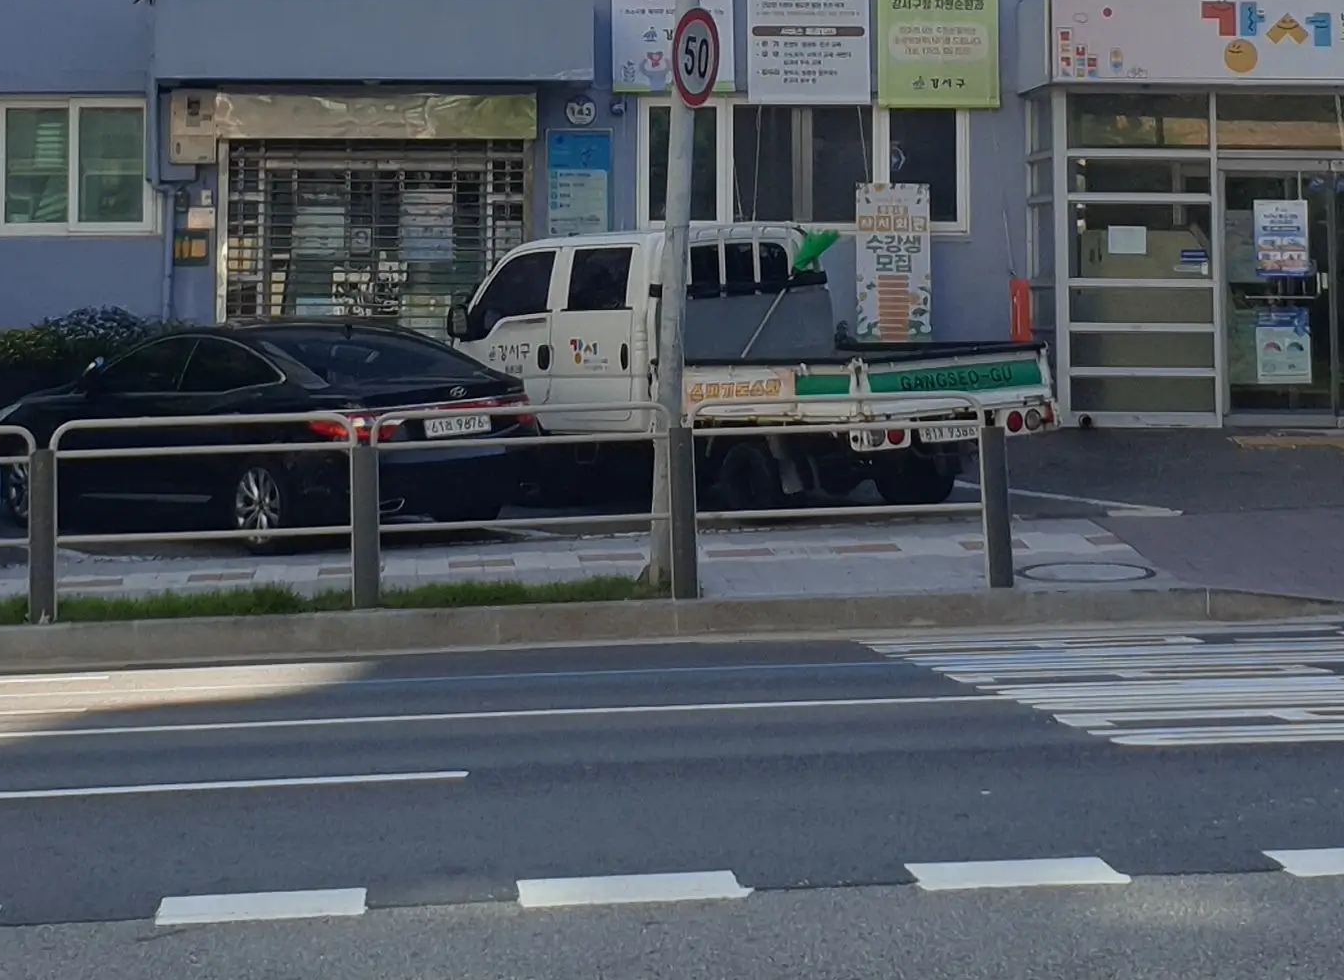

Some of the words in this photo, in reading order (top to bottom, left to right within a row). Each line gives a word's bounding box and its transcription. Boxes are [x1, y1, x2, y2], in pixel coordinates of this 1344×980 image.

[683, 35, 710, 80] 50
[866, 234, 922, 254] 수강생
[875, 254, 913, 273] 모집
[900, 365, 1014, 393] GANGSEO-GU
